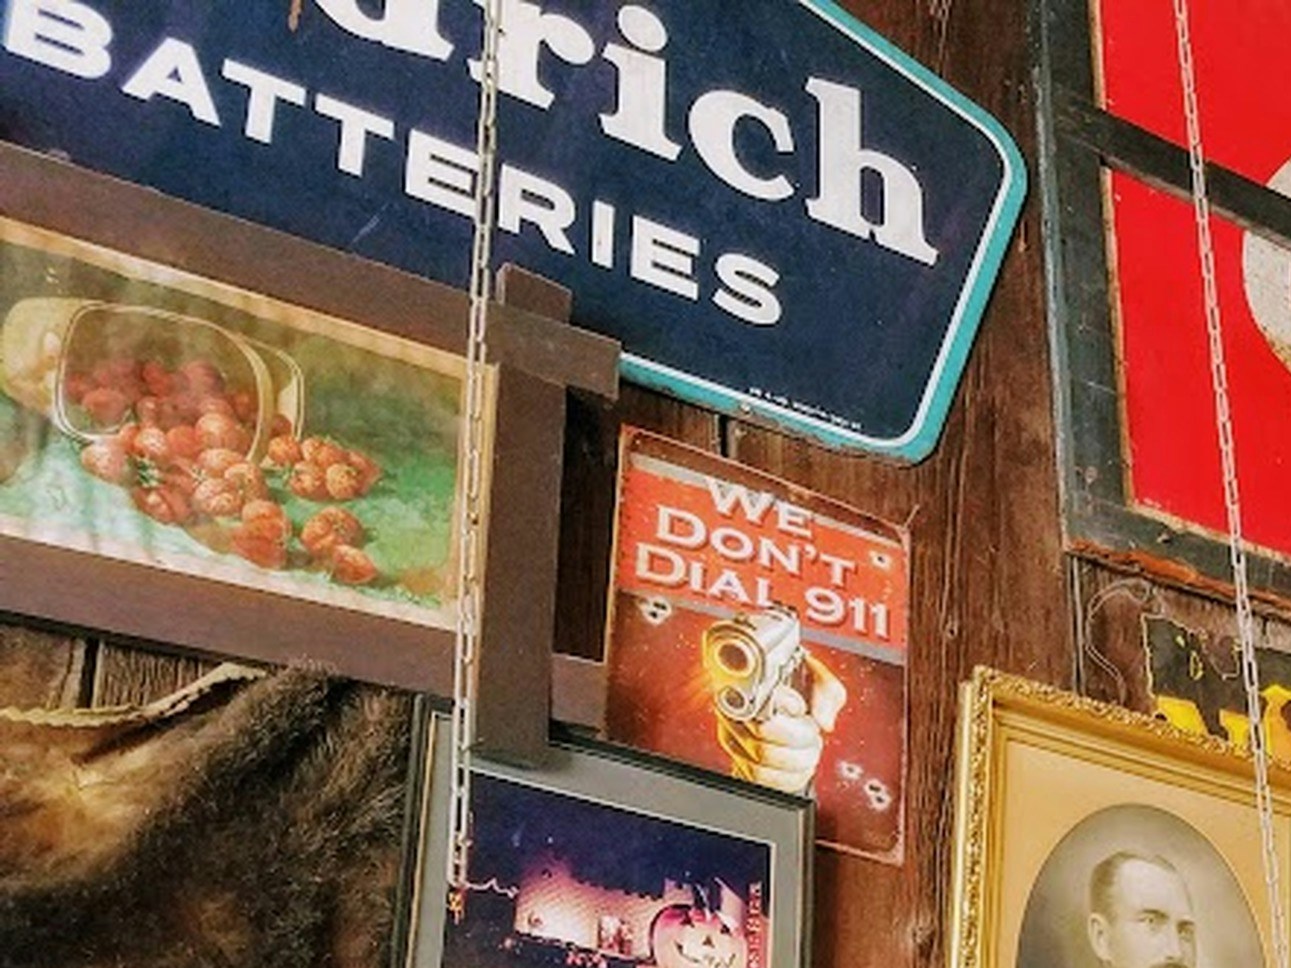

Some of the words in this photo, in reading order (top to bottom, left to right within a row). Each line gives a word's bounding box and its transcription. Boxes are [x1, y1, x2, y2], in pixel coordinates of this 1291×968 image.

[4, 0, 784, 326] BATTERIES
[655, 504, 859, 588] DON'T
[707, 478, 815, 541] WE
[805, 586, 891, 640] 911
